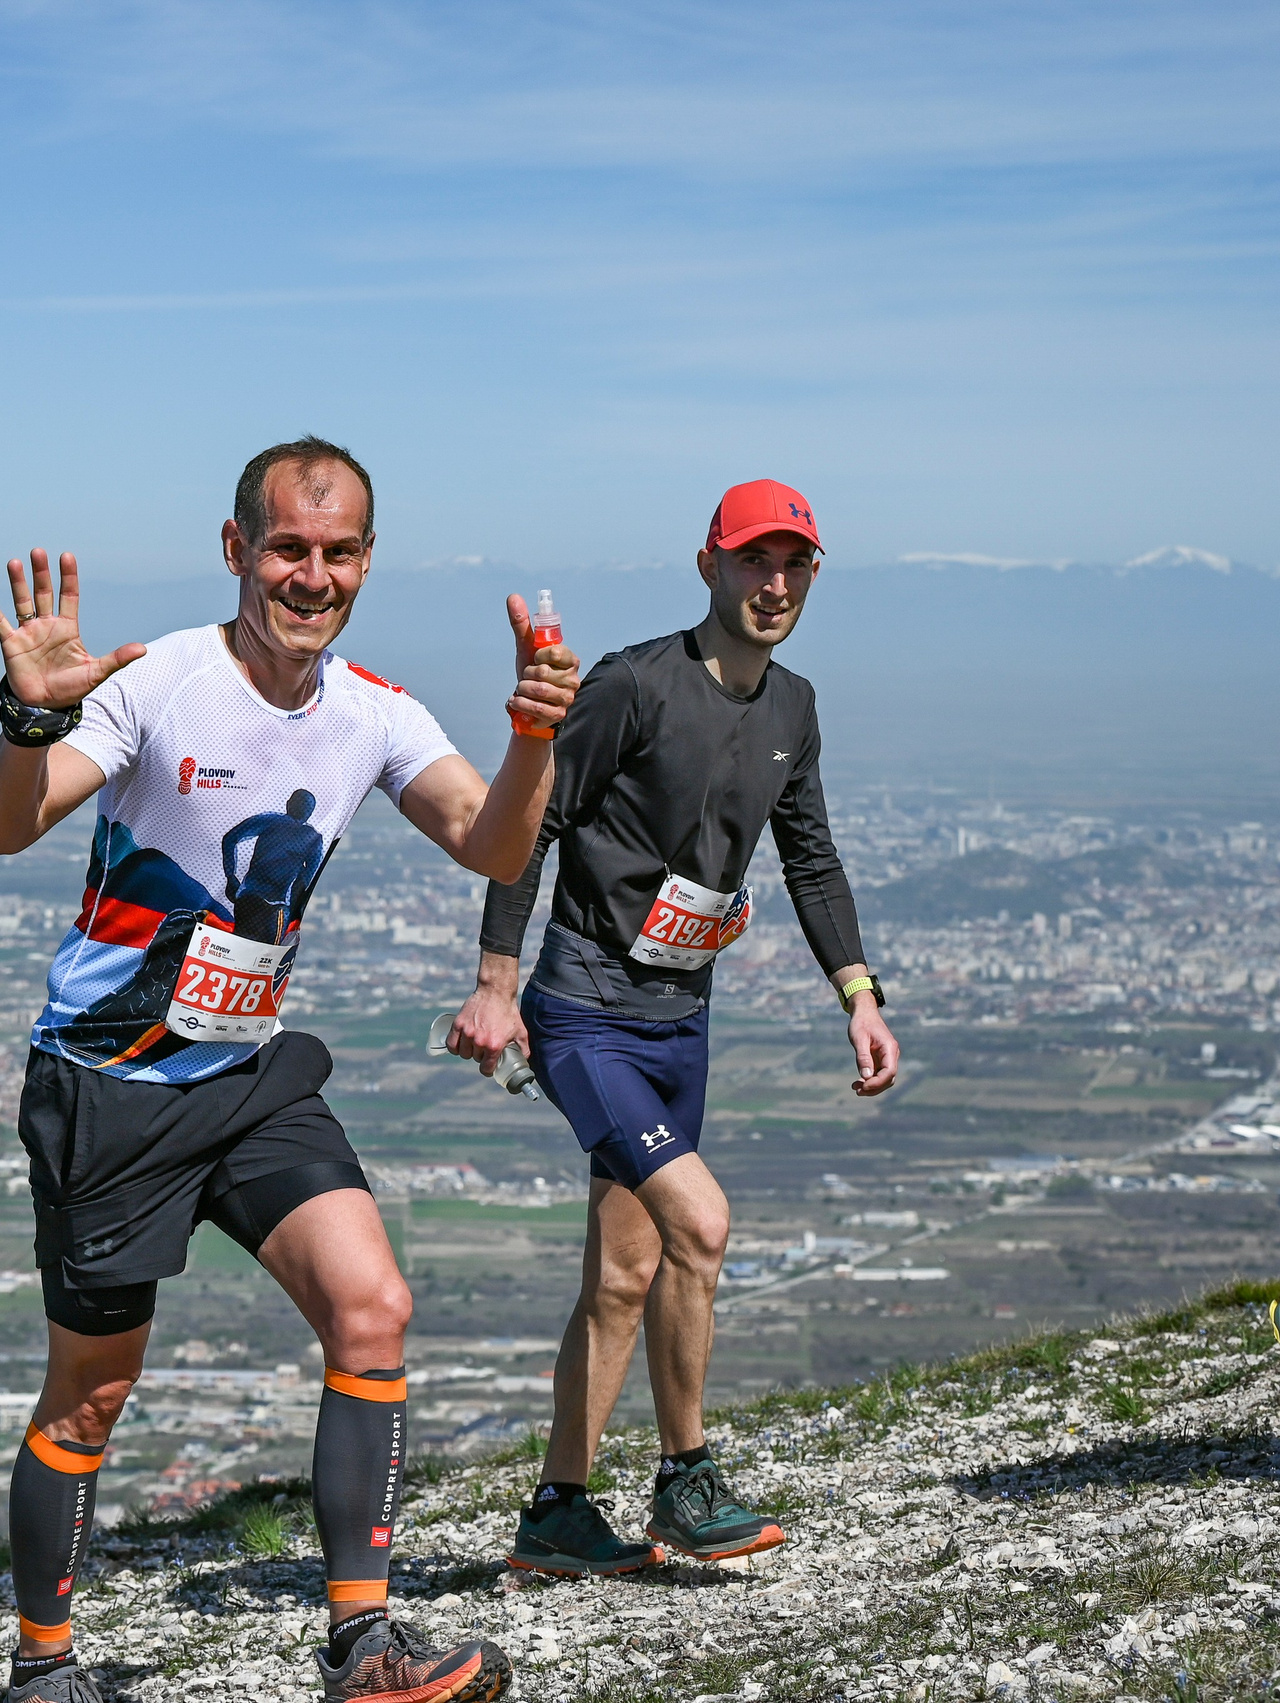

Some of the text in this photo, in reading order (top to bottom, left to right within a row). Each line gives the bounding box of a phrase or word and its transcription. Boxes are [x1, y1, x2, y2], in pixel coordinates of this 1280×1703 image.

[287, 711, 306, 720] EVERY
[197, 779, 221, 789] HILLS
[198, 767, 236, 779] PLOVDIV
[648, 906, 715, 947] 2192
[210, 943, 231, 954] PLOVDIV
[178, 963, 267, 1013] 2378
[381, 1412, 401, 1522] COMPRESSPORT
[66, 1481, 87, 1574] COMPRESSPORT
